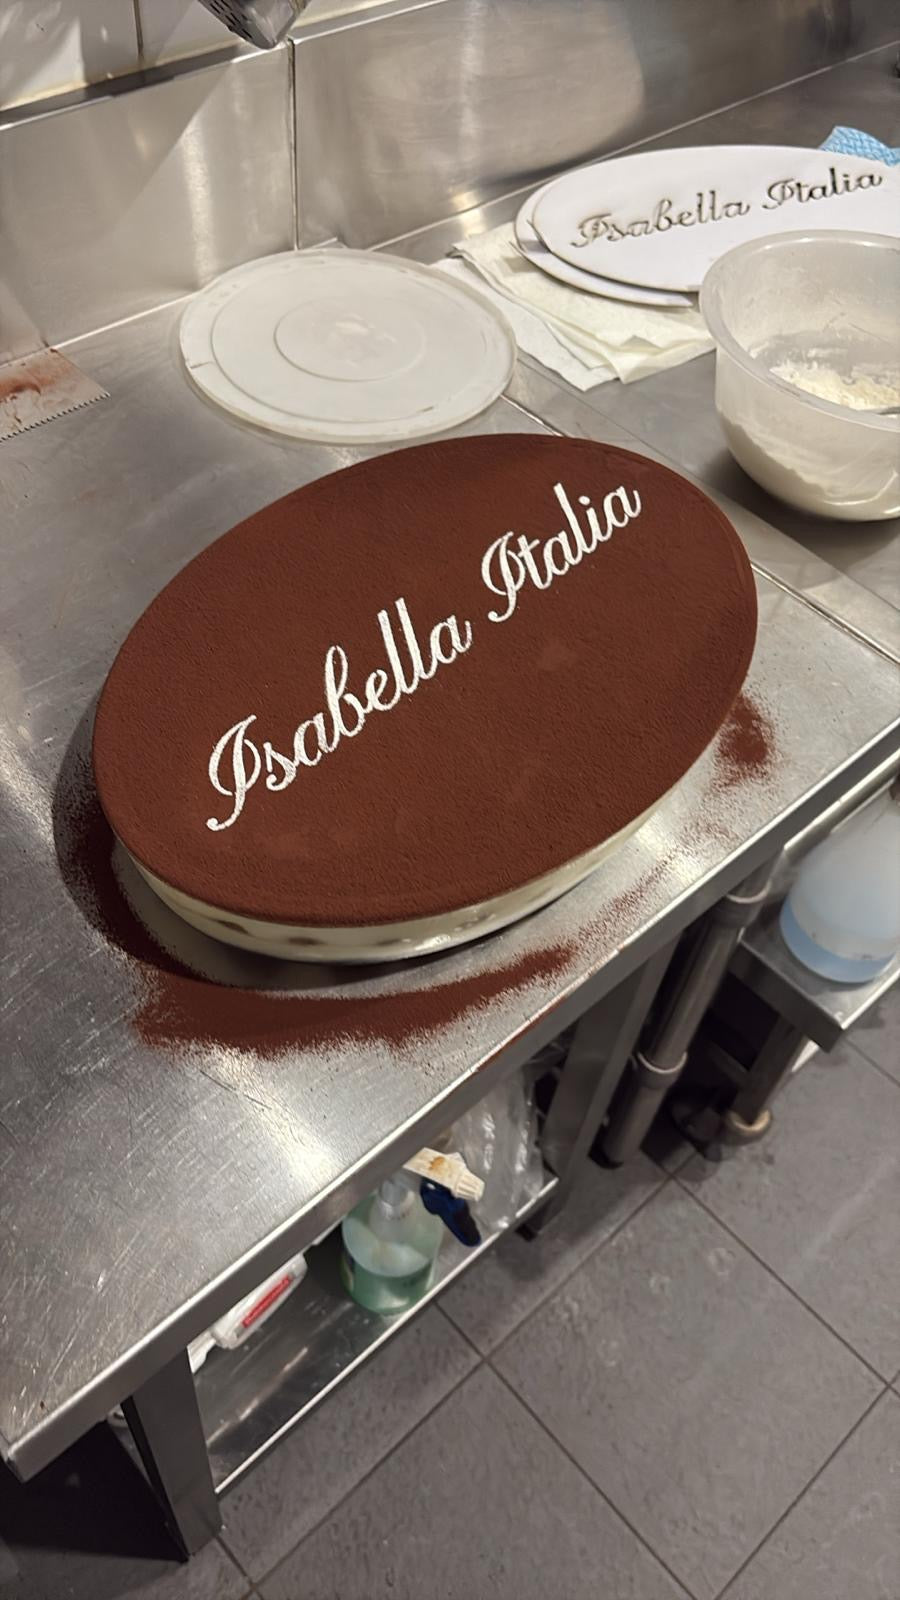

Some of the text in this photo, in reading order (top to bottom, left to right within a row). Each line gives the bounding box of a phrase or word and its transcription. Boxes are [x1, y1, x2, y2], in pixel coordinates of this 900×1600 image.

[571, 167, 883, 248] Isabella Italia
[206, 482, 642, 831] Isabella Italia
